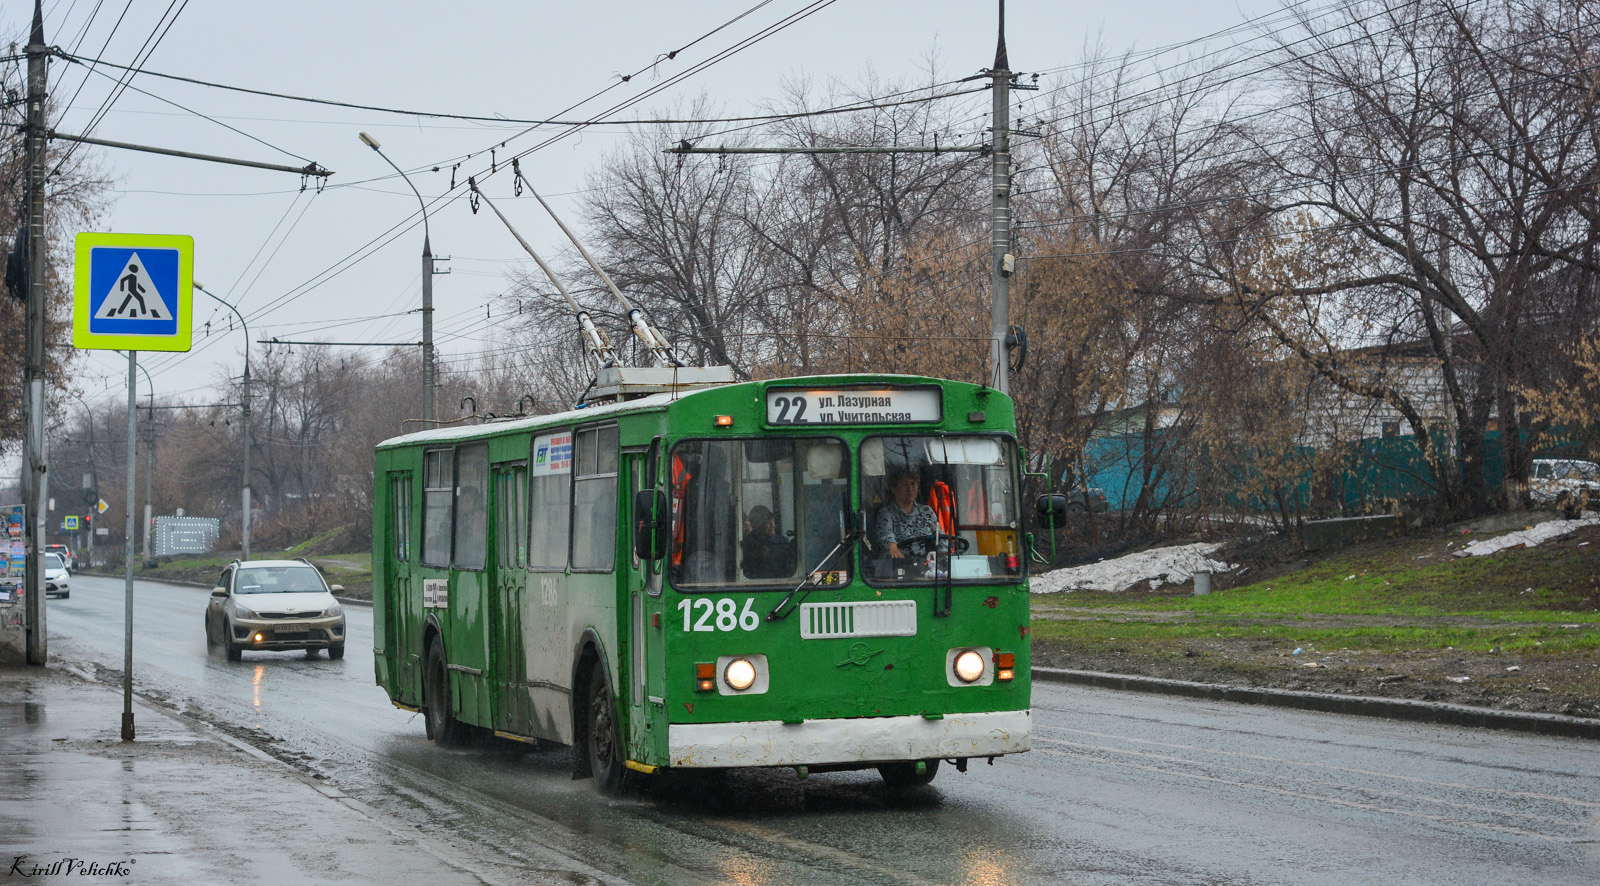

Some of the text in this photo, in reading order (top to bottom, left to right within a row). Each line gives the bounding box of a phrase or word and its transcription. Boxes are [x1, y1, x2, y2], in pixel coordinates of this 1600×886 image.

[774, 396, 808, 423] 22
[818, 395, 891, 409] ул. Лазурная
[838, 411, 912, 422] Учительская
[677, 597, 760, 632] 1286
